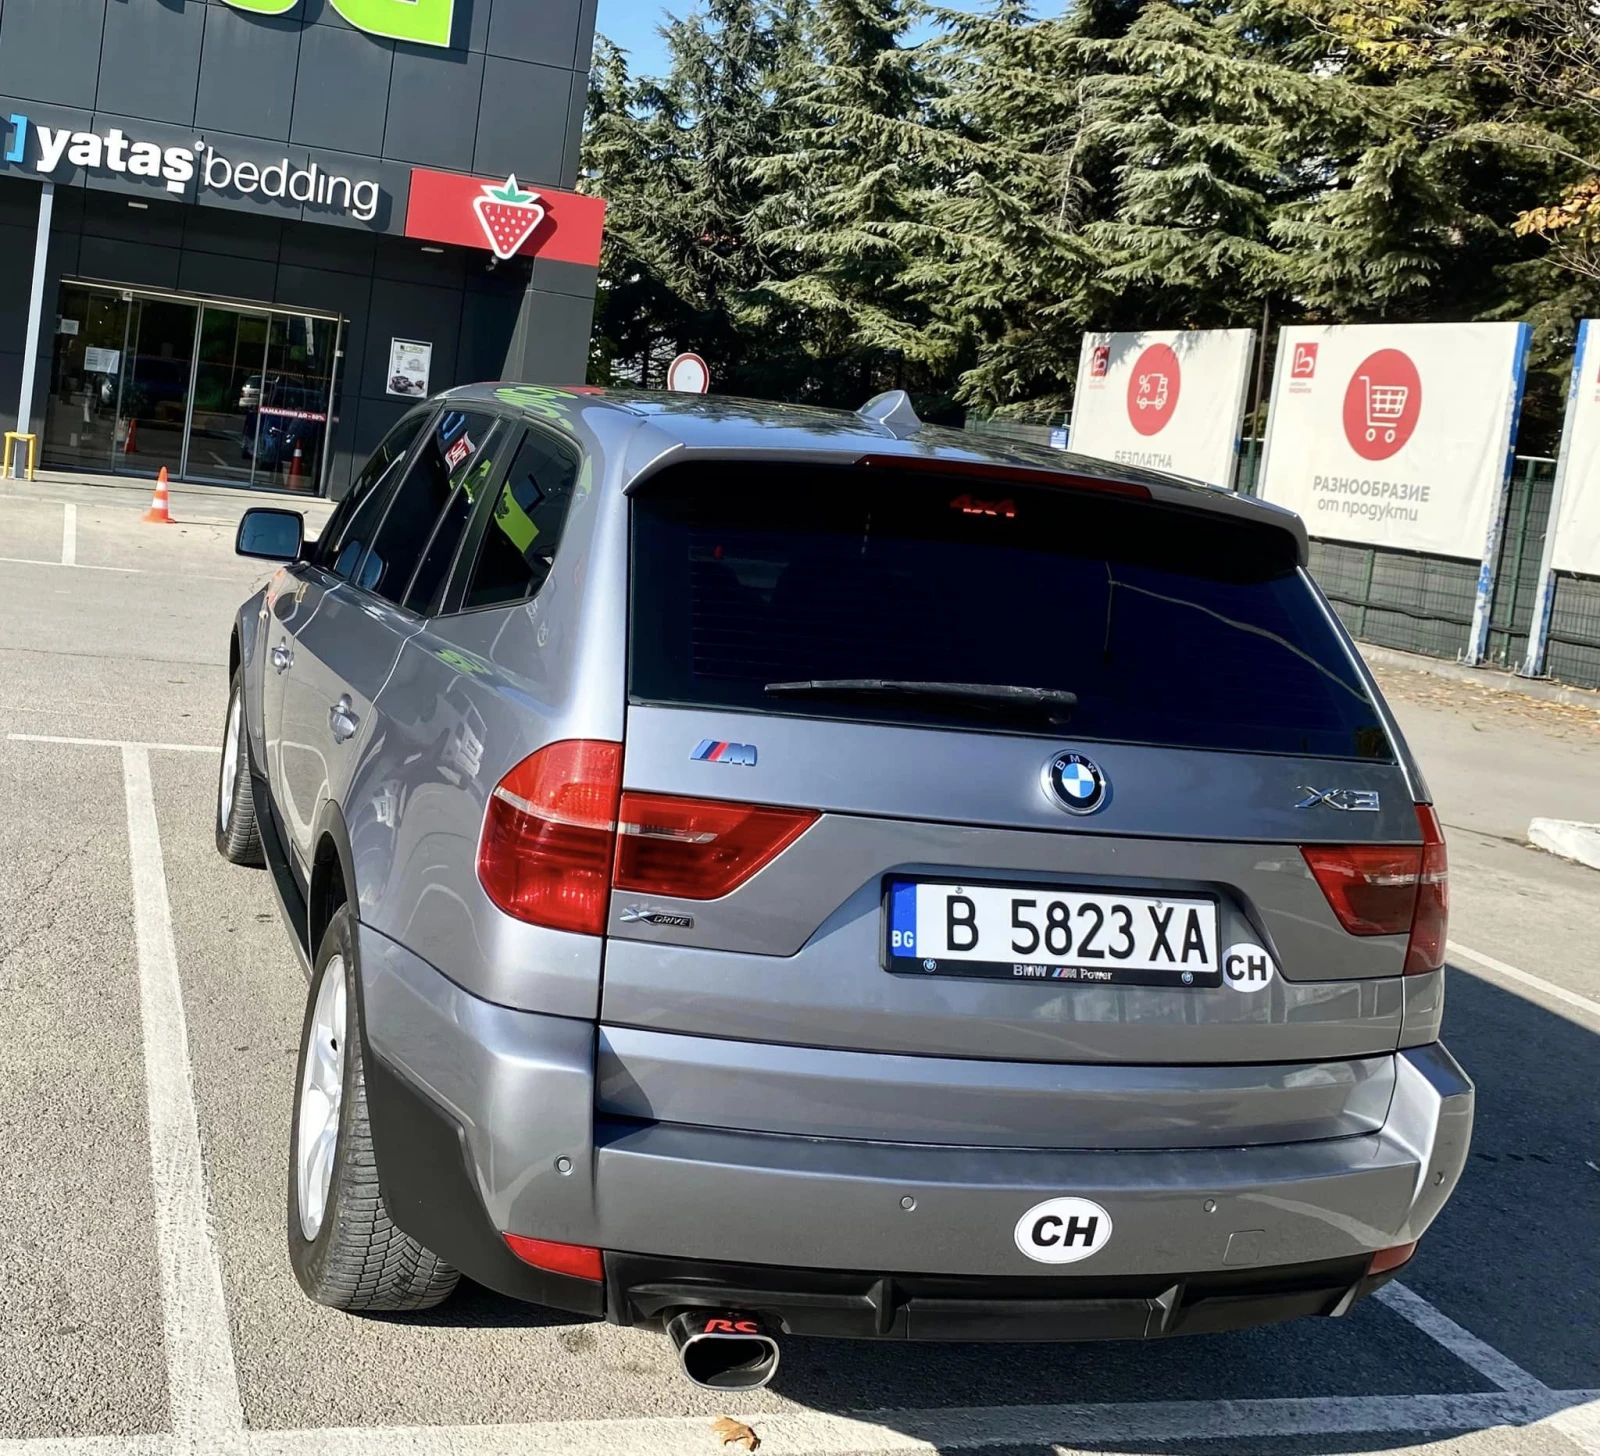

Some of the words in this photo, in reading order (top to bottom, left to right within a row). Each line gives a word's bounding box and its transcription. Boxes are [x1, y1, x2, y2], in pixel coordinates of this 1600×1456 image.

[36, 125, 194, 194] yataş
[1114, 450, 1173, 469] БЕЗПЛАТНА
[1313, 475, 1431, 502] РАЗНООБРАЗИЕ
[1317, 498, 1340, 513] от
[1341, 501, 1419, 522] продукти
[1054, 754, 1097, 773] BMW
[891, 930, 914, 948] BG
[946, 895, 979, 951] B
[1011, 898, 1135, 960] 5823
[1147, 905, 1209, 964] XA
[1013, 963, 1047, 977] BMW
[1080, 968, 1113, 980] Power
[1225, 954, 1268, 981] CH
[1031, 1215, 1099, 1247] CH
